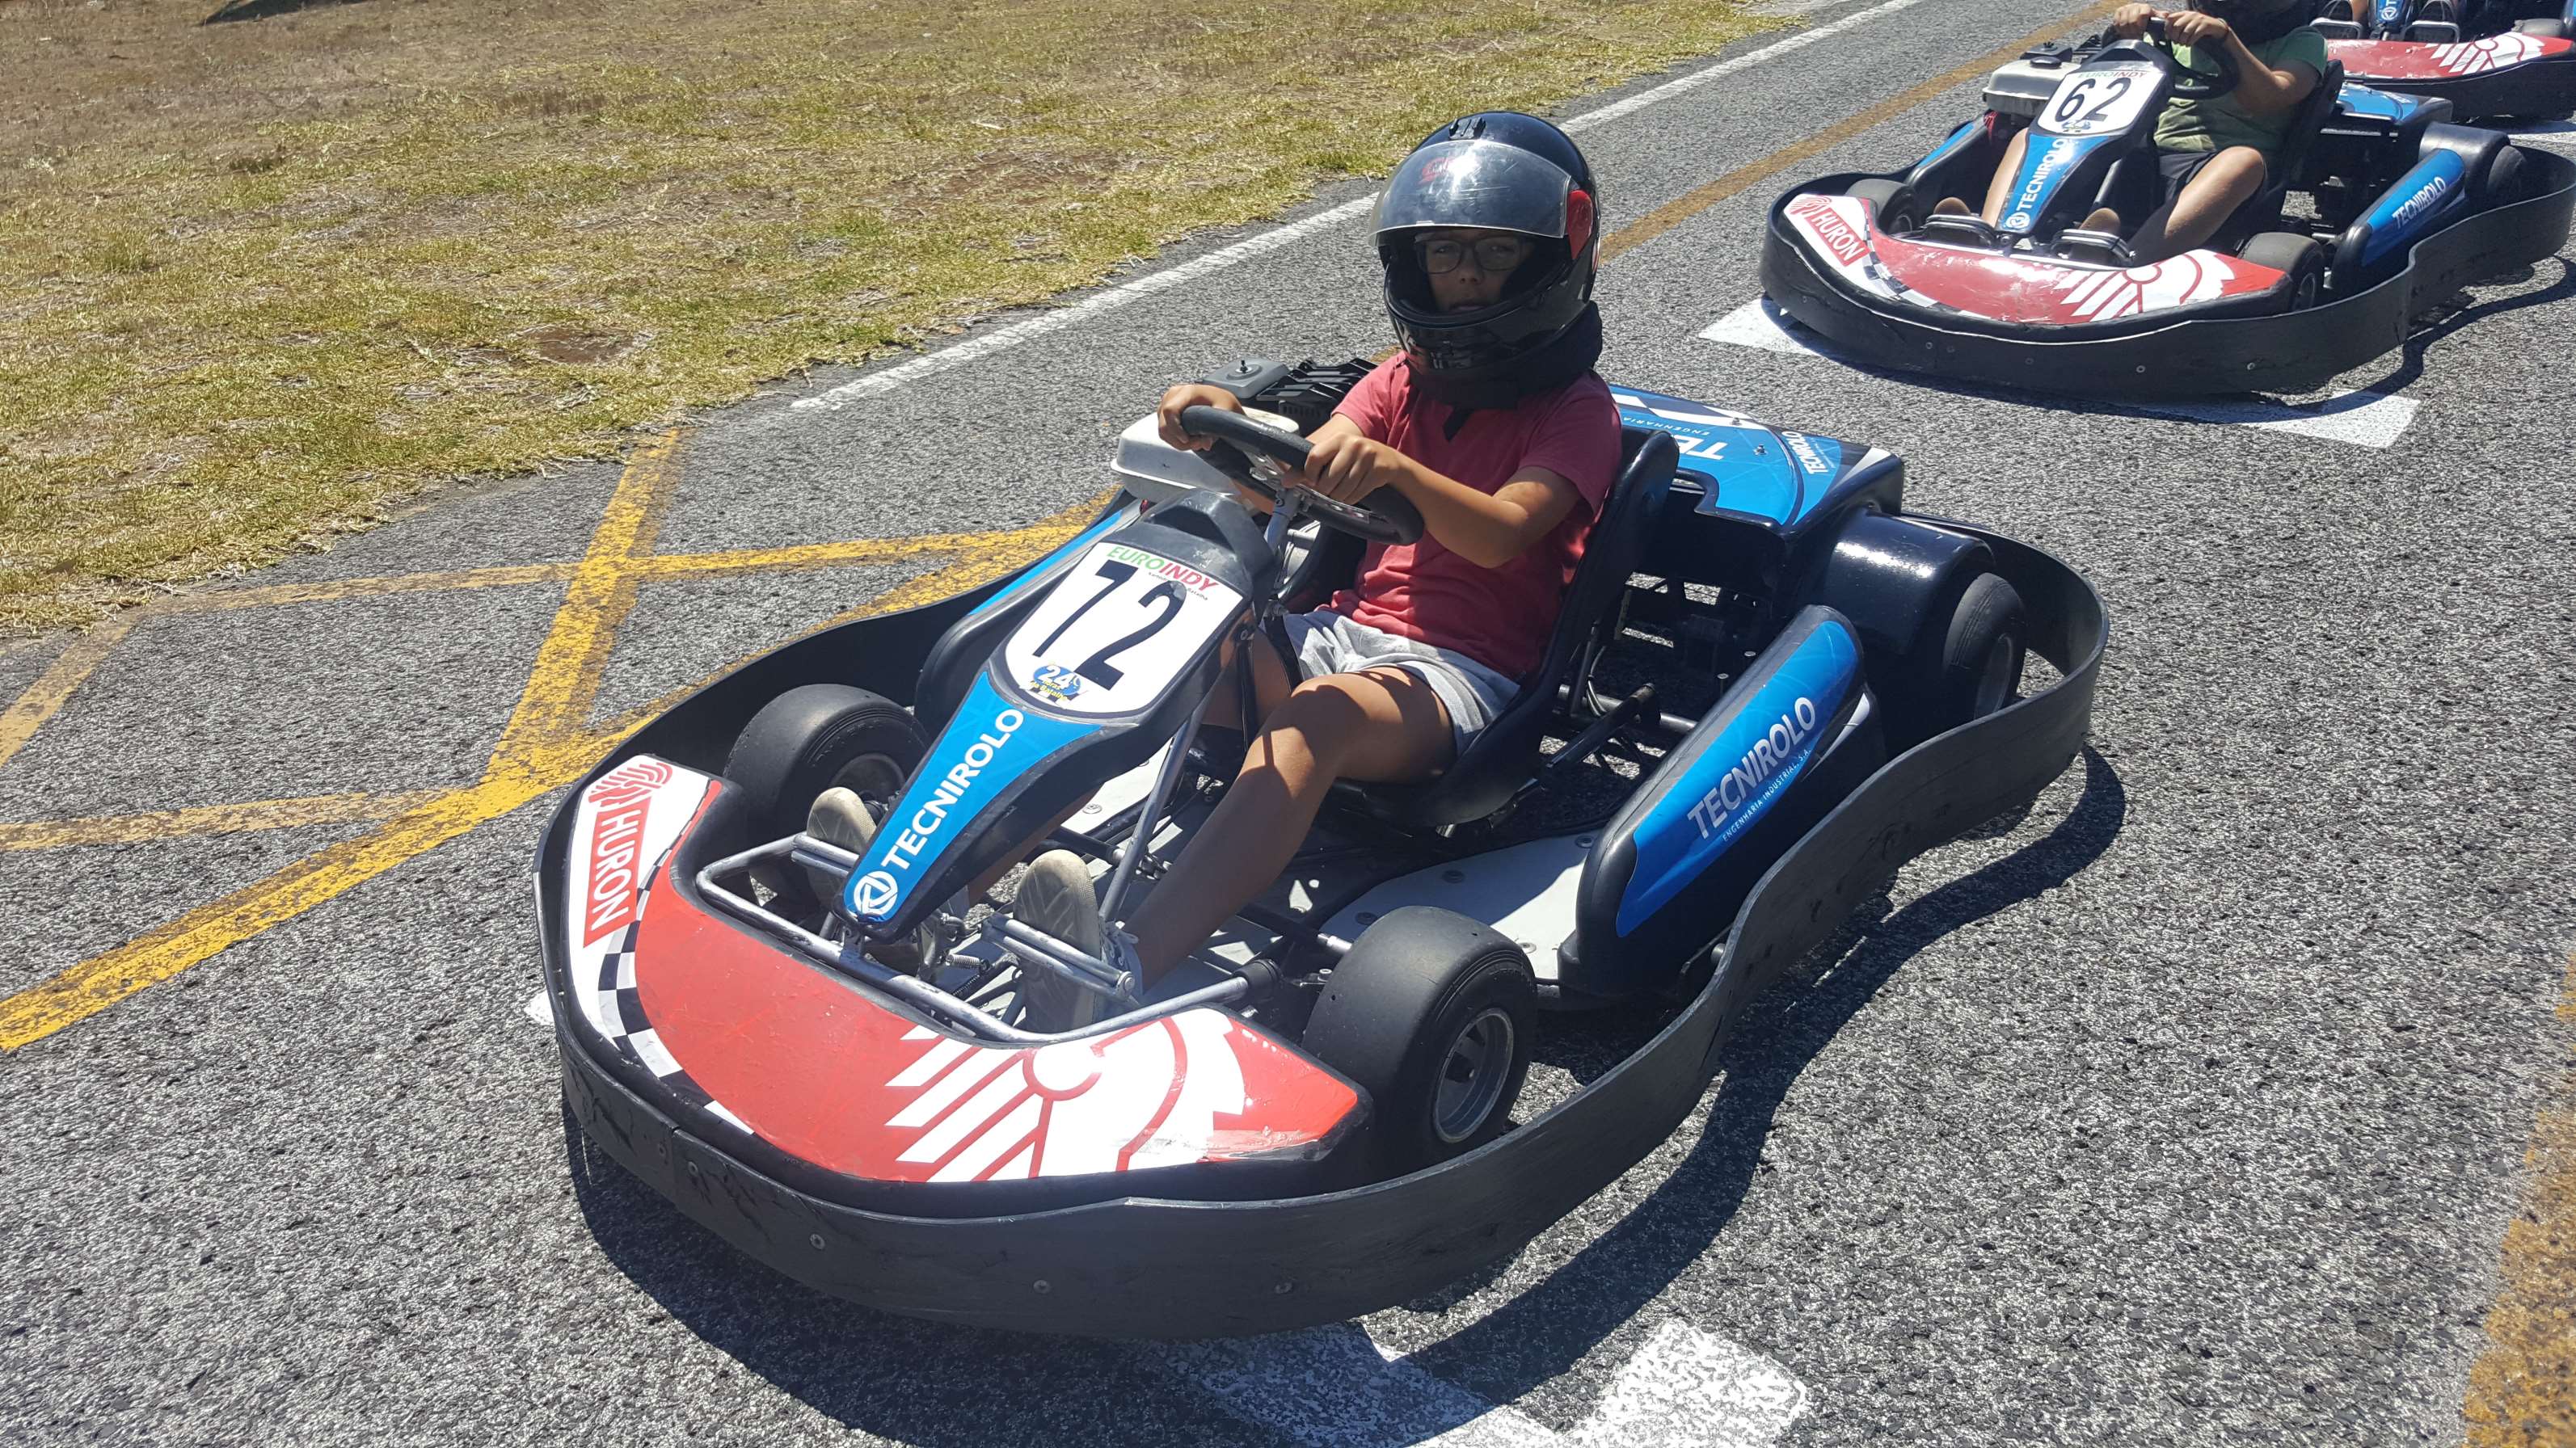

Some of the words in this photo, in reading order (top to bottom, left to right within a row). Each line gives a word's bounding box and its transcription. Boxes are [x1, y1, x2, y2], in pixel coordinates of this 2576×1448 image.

[2055, 77, 2131, 123] 62
[2017, 138, 2064, 211] TECNIROLO
[2392, 176, 2446, 229] TECNIROLO
[1811, 212, 1866, 261] HURON
[1623, 417, 1710, 436] ENGENHARIA
[1781, 431, 1829, 475] TECNIROLO
[1107, 545, 1219, 591] EUROINDY
[1032, 559, 1187, 691] 72
[1038, 665, 1077, 689] 24
[881, 709, 1024, 870] TECNIROLO
[1687, 697, 1815, 840] TECNIROLO
[1722, 799, 1764, 841] ENGENHARIA
[591, 809, 642, 932] HURON
